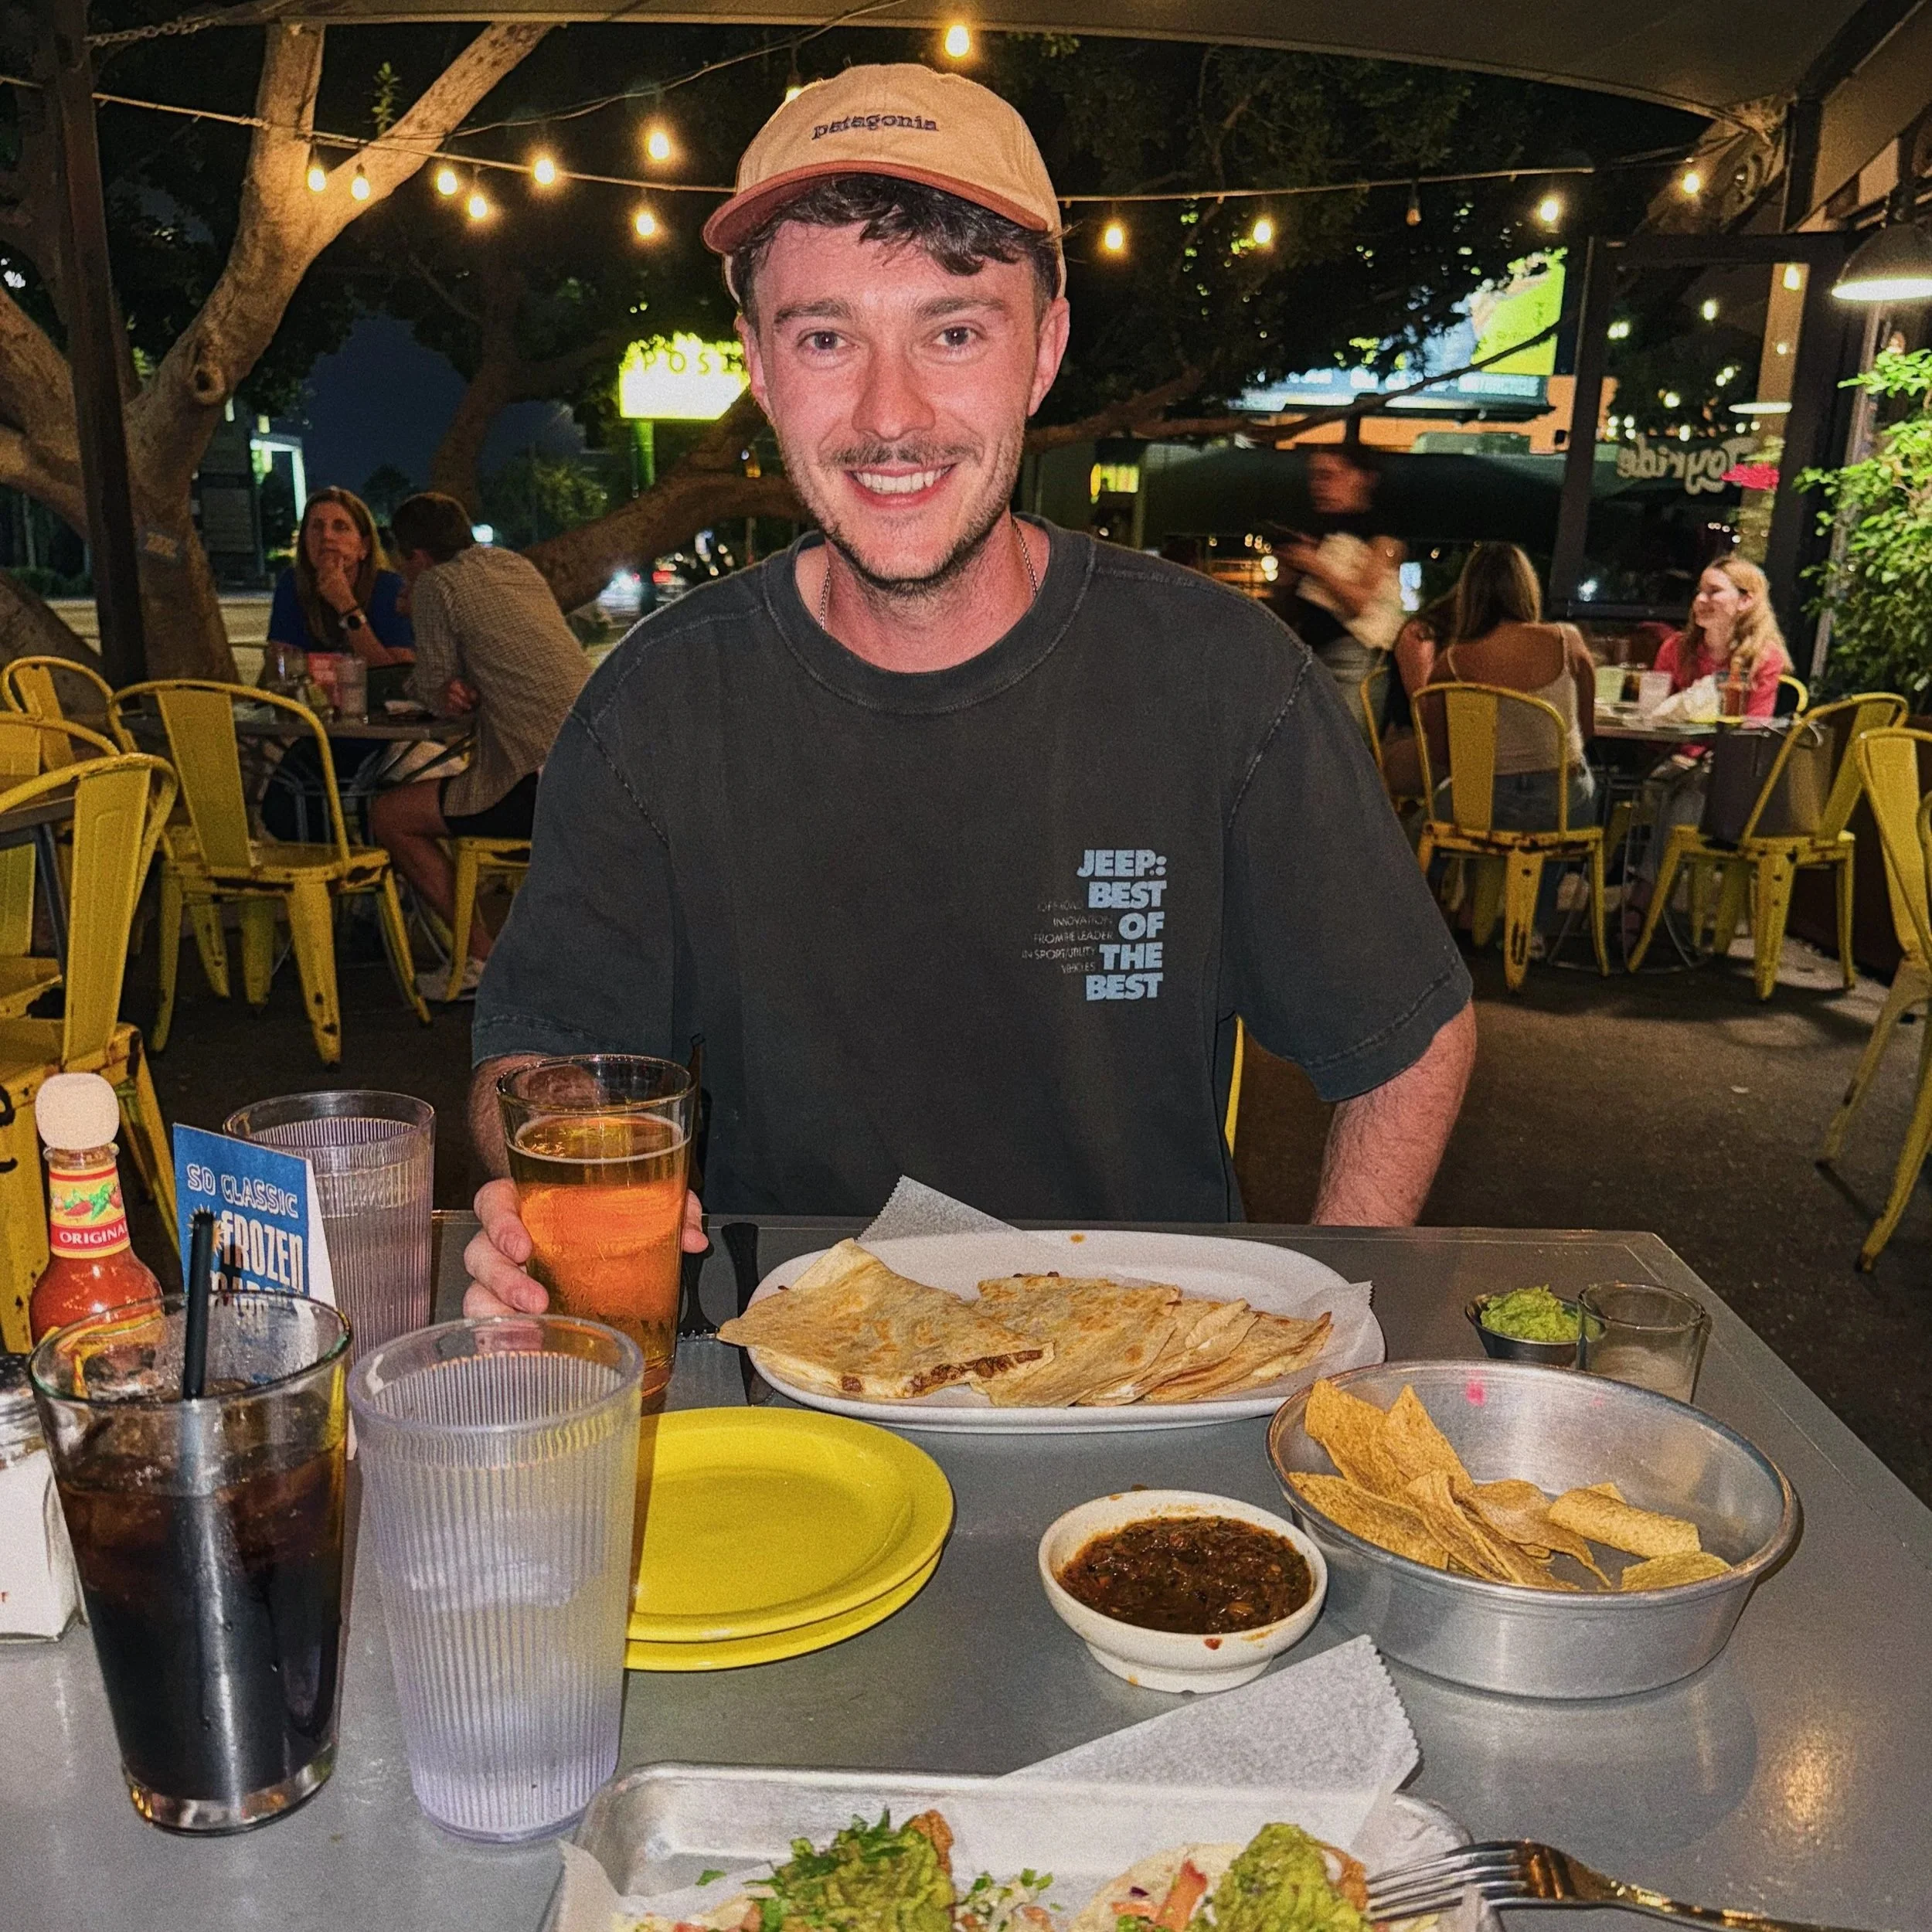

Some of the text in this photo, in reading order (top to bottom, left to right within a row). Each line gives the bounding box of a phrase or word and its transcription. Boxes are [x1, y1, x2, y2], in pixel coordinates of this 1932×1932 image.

[811, 114, 939, 140] patagonia
[1088, 880, 1167, 909] BEST
[1118, 911, 1165, 940] OF
[1099, 942, 1163, 970] THE
[1086, 972, 1163, 1001] BEST
[186, 1163, 299, 1219] SO CLASSIC
[220, 1209, 304, 1294] FROZEN
